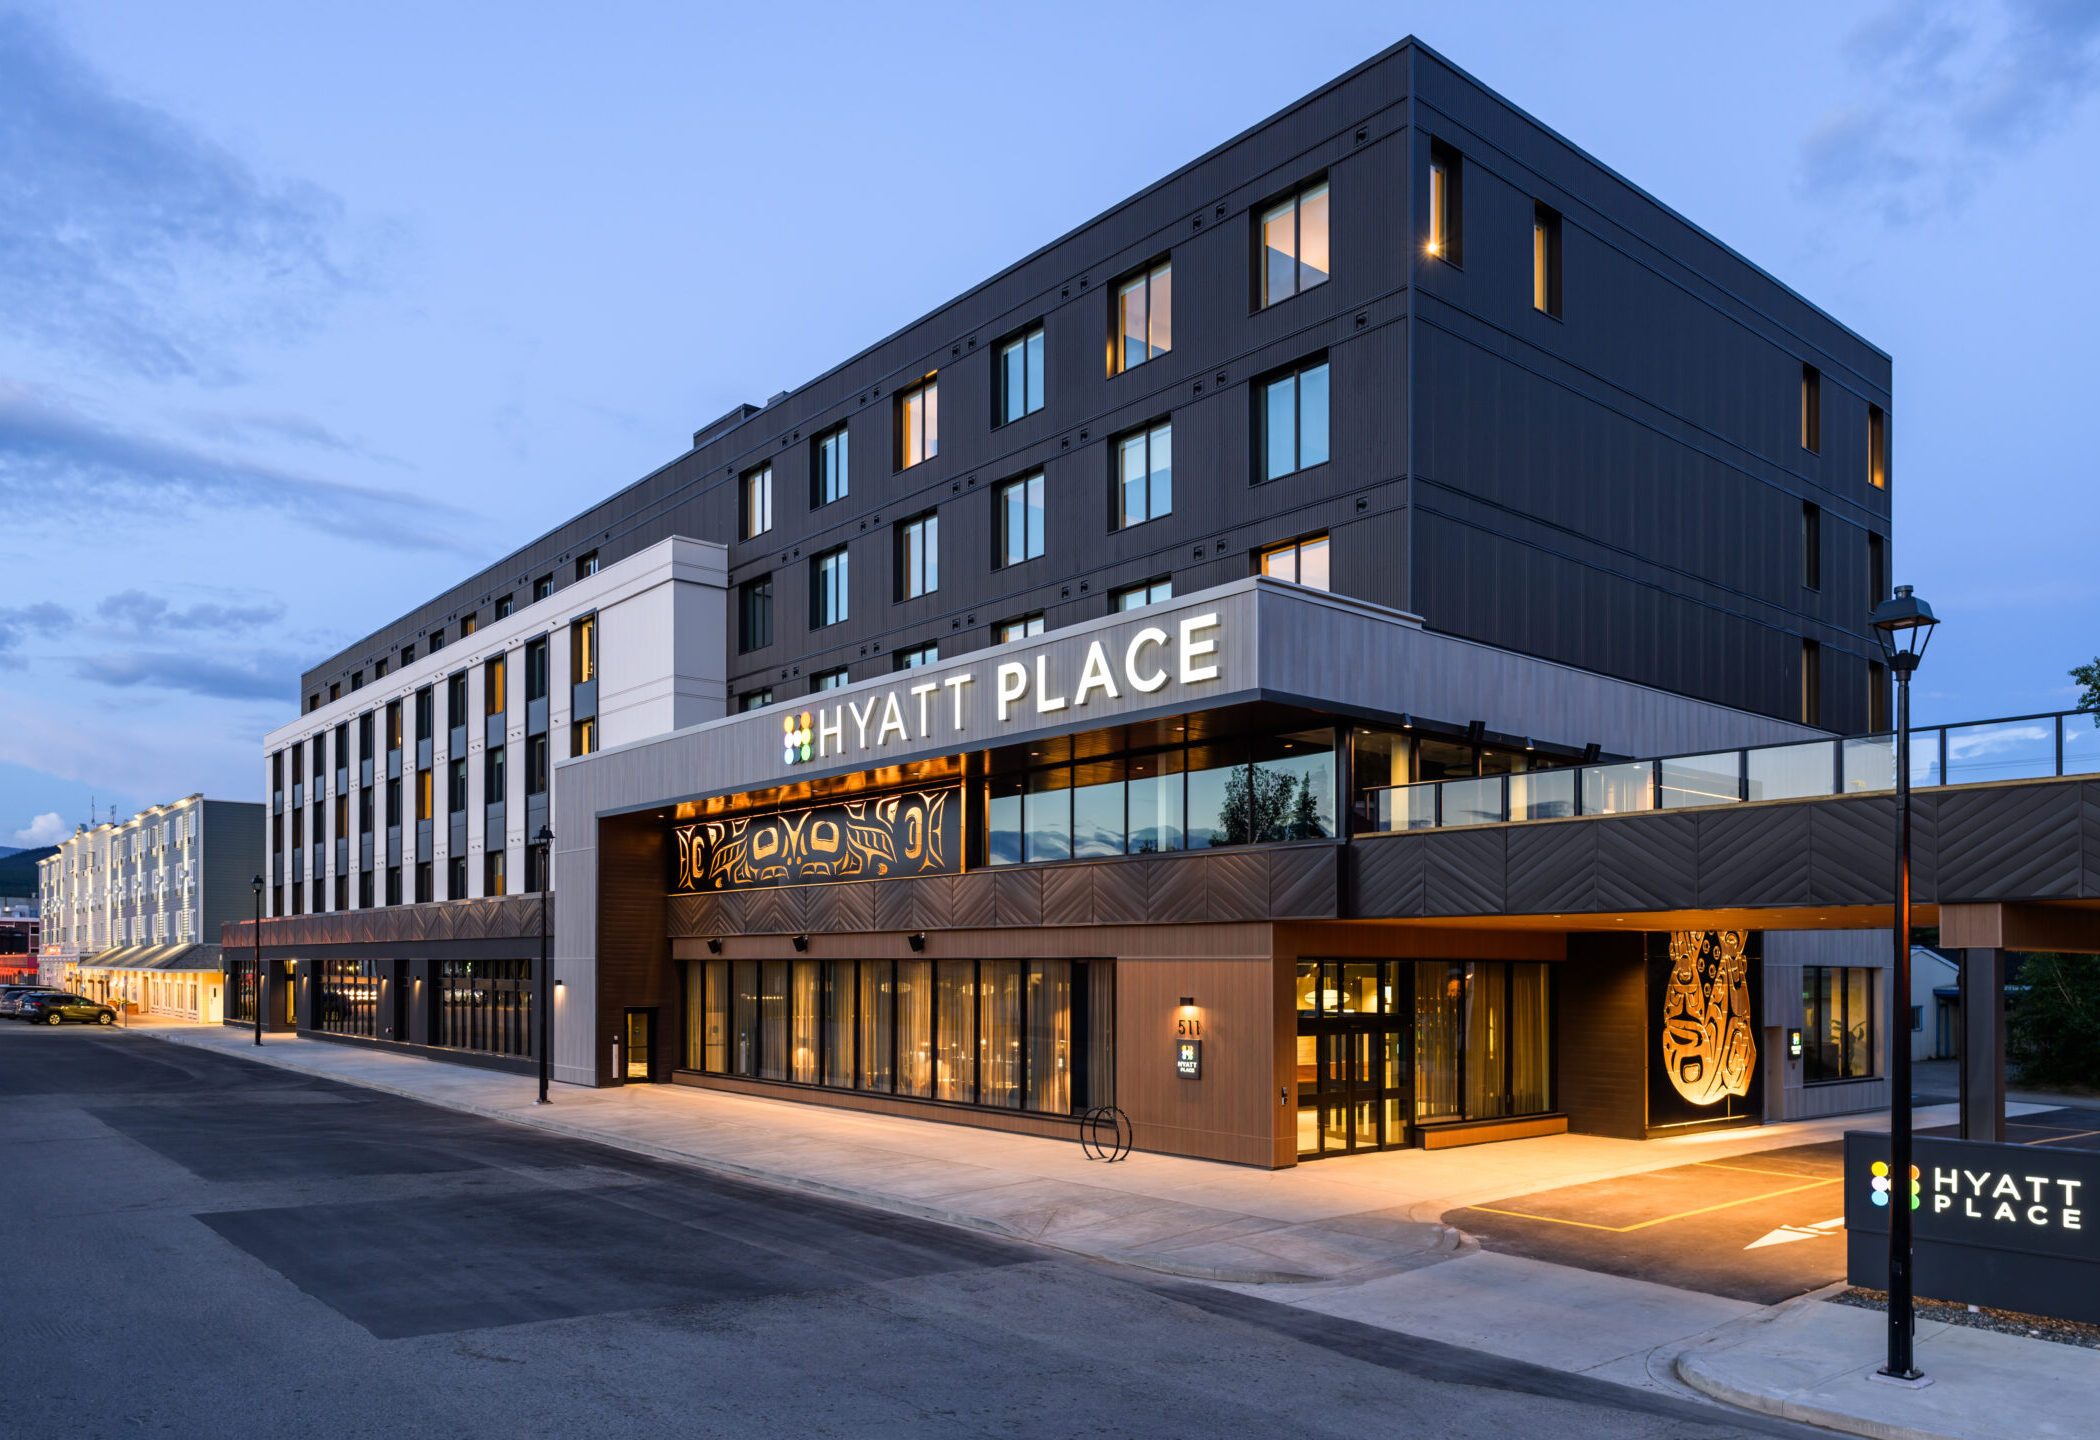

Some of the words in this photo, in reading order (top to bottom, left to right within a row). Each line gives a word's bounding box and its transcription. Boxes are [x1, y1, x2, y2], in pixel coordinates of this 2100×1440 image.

[820, 674, 974, 757] HYATT
[997, 612, 1221, 722] PLACE
[1178, 1019, 1200, 1035] 511
[1934, 1167, 2082, 1206] HYATT
[1934, 1194, 2082, 1229] PLACE
